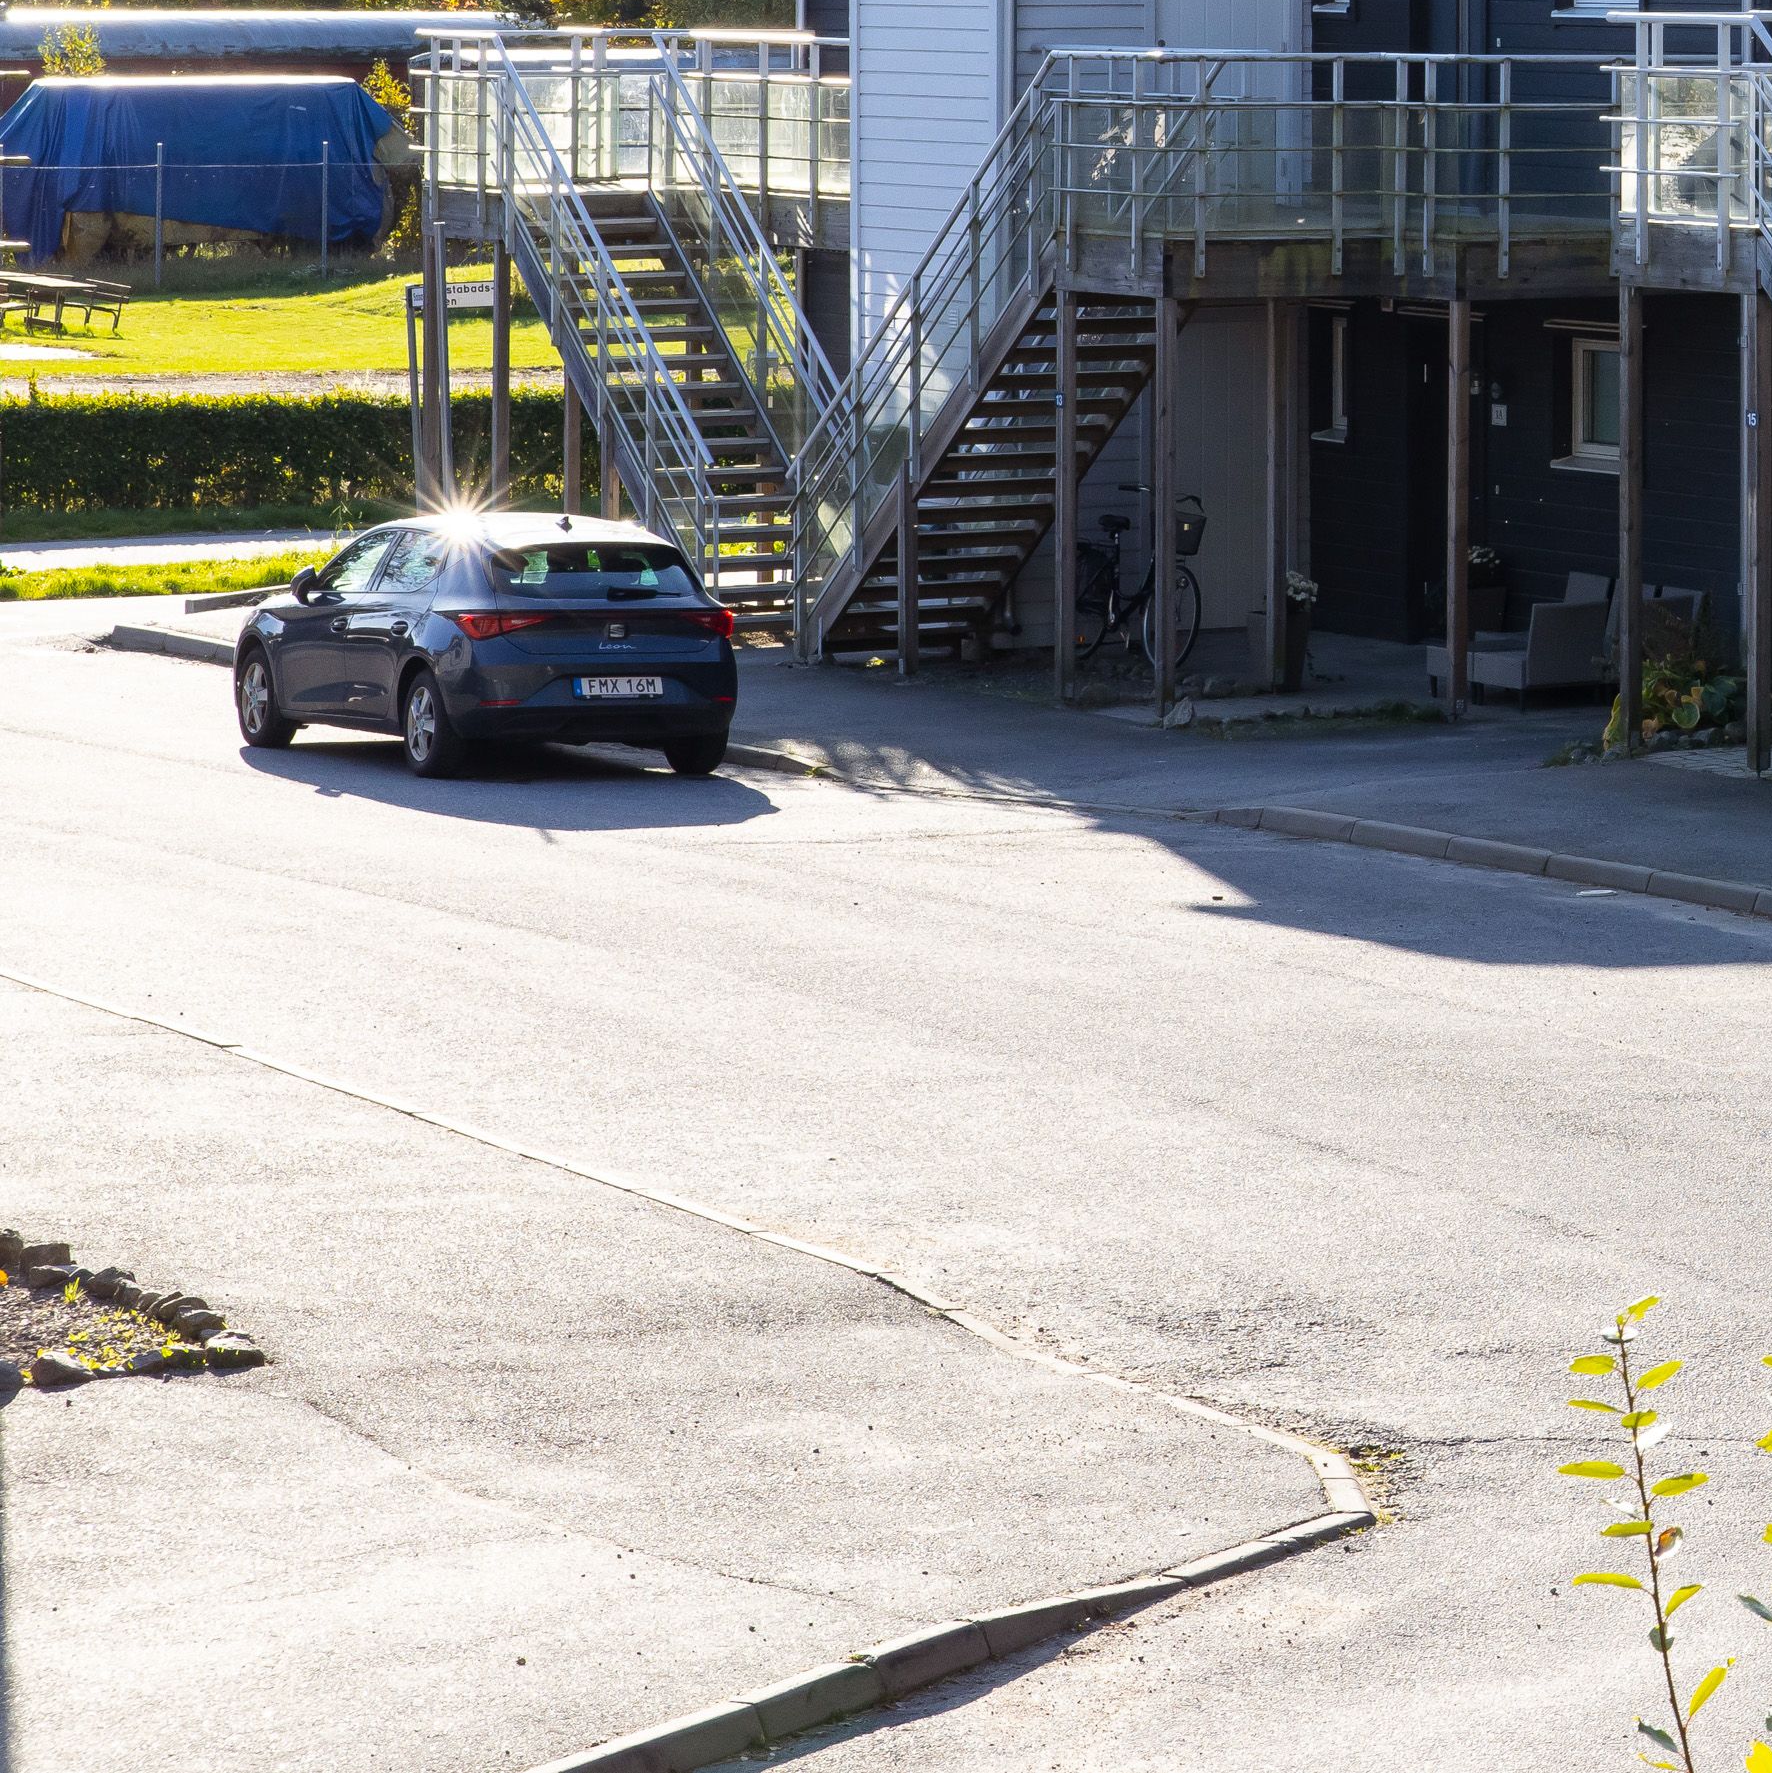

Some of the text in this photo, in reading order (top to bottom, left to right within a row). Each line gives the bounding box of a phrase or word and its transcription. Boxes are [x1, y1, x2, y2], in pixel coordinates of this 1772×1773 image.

[446, 284, 494, 294] stabads-
[1747, 413, 1756, 426] 15
[599, 642, 636, 650] Leon
[588, 679, 656, 694] FMX 16M
